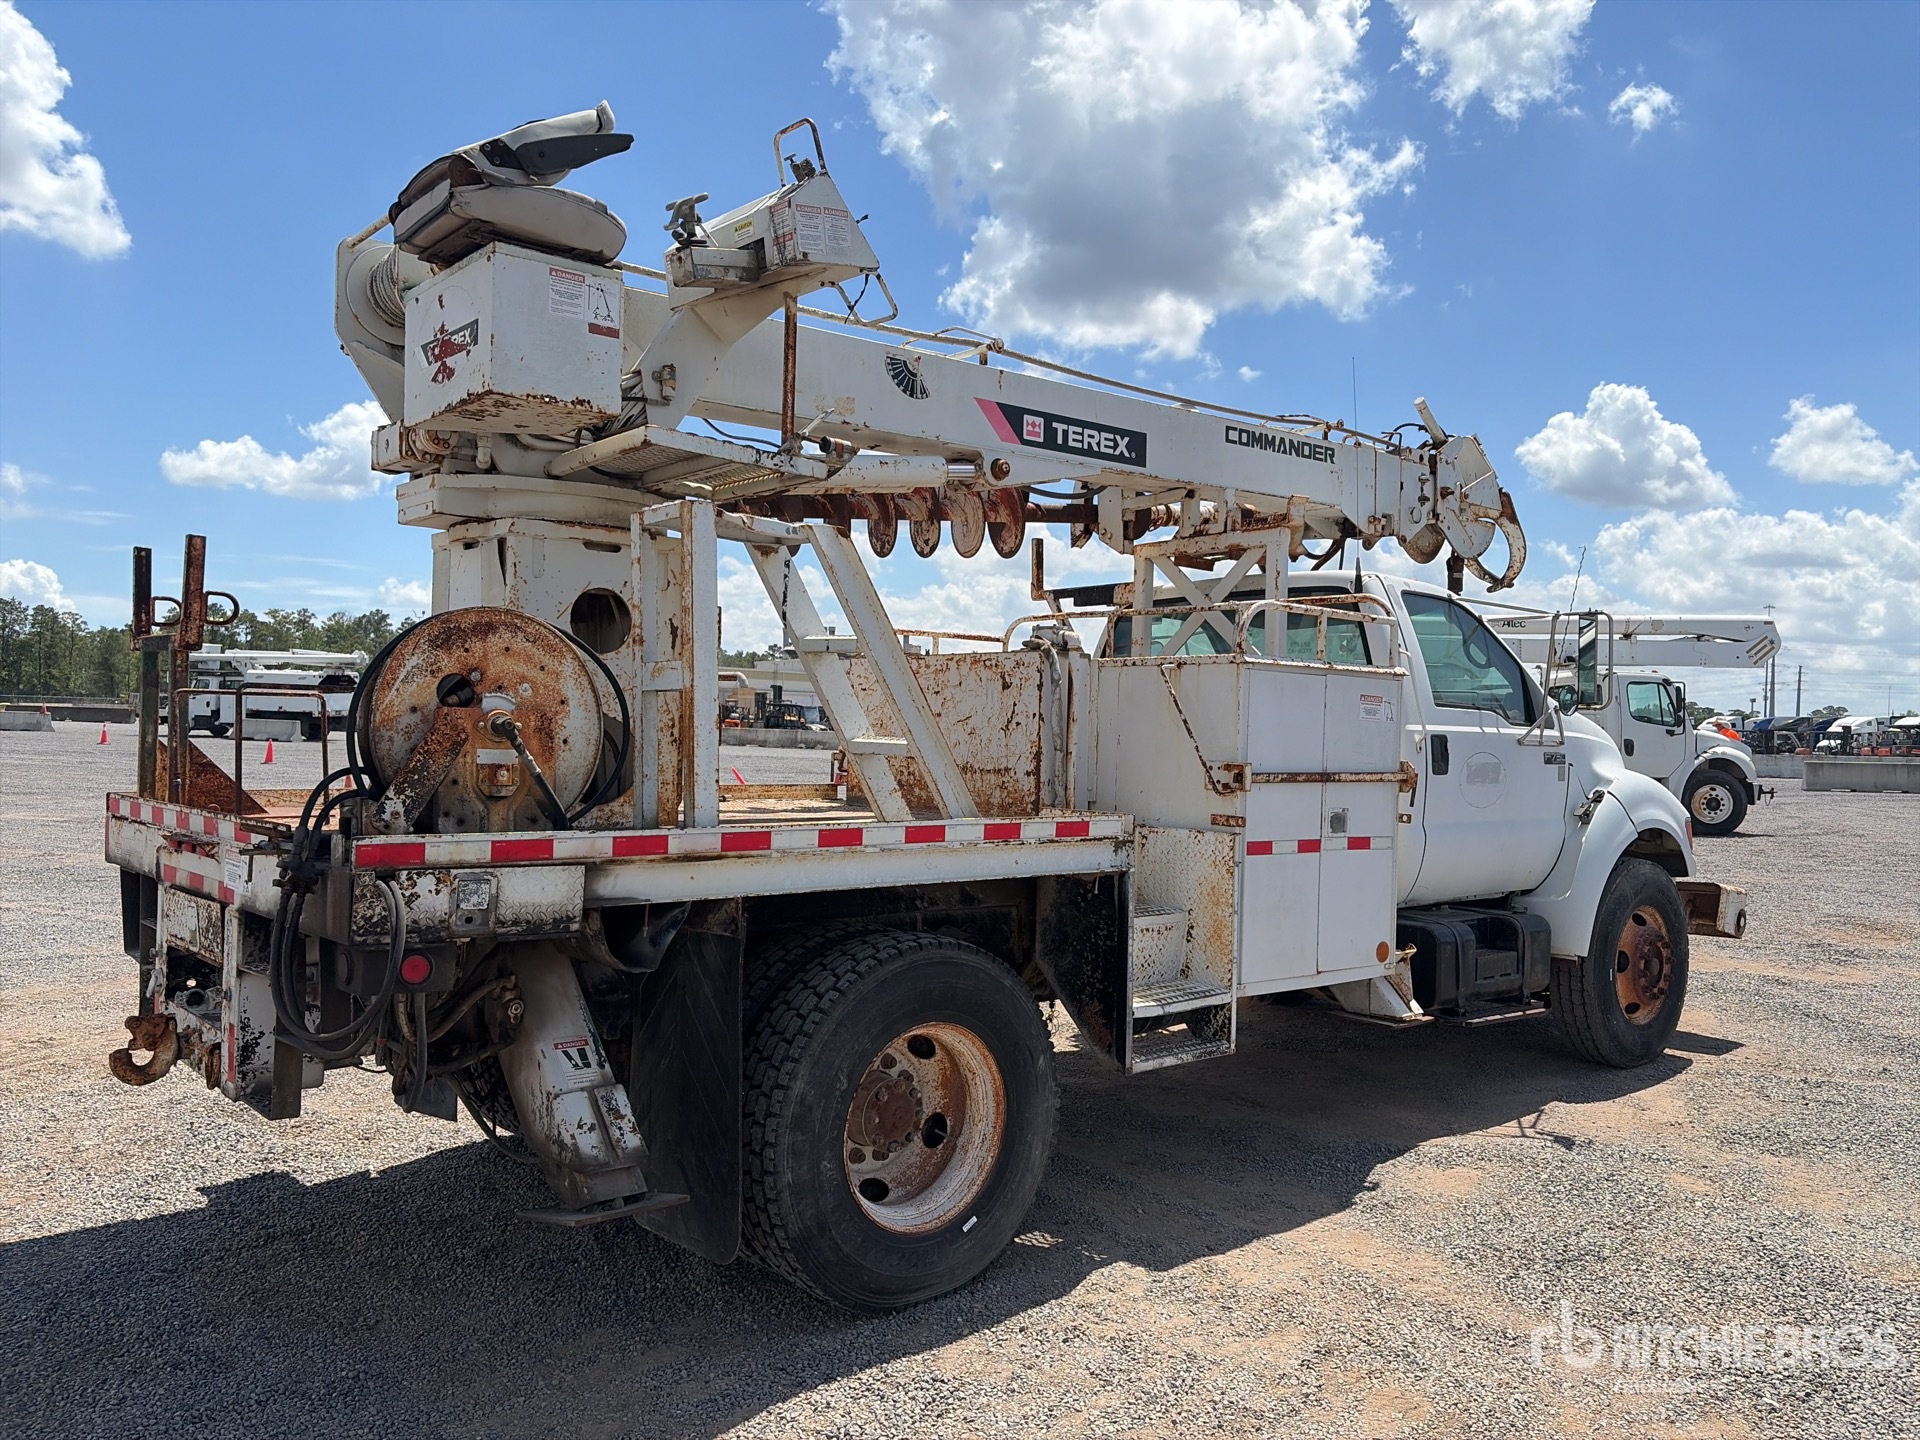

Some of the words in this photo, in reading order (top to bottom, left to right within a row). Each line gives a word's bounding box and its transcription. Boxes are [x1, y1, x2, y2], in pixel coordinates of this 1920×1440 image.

[801, 205, 821, 214] DANGER
[828, 208, 848, 218] DANGER
[557, 271, 584, 282] DANGER
[1052, 421, 1131, 458] TEREX
[1225, 425, 1336, 465] COMMANDER
[1502, 620, 1527, 629] Altec
[1365, 695, 1382, 703] DANGER
[563, 1040, 586, 1048] DANGER
